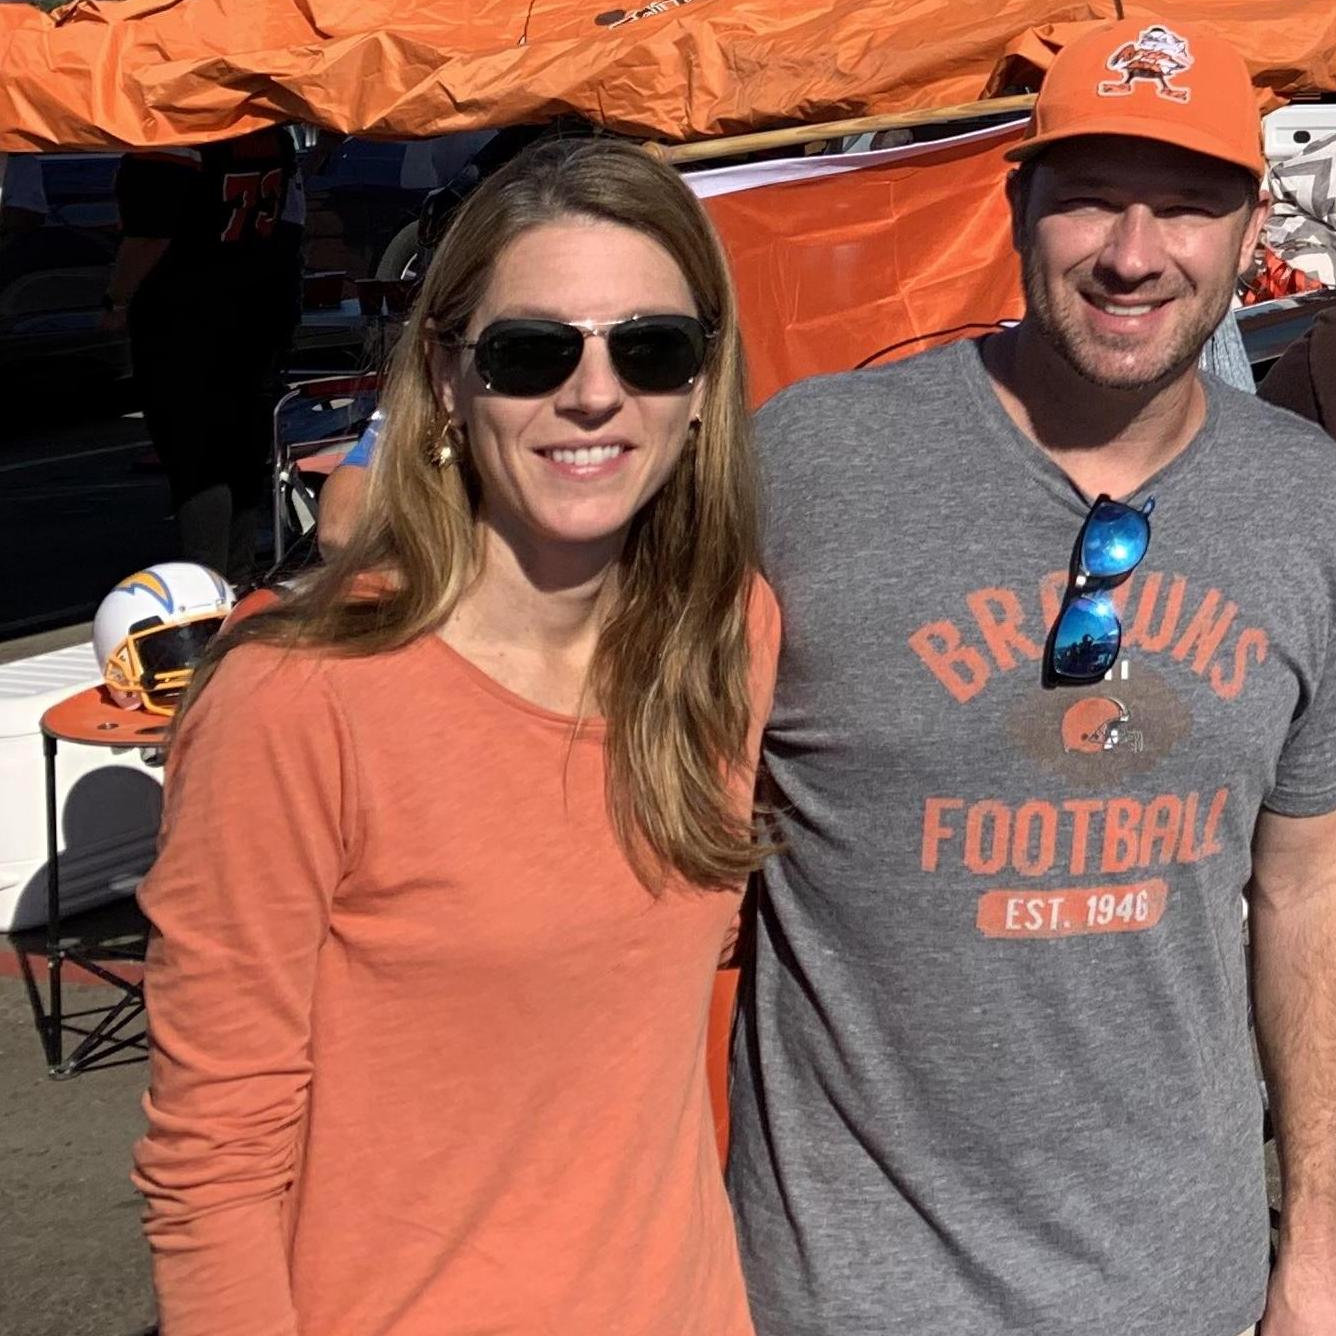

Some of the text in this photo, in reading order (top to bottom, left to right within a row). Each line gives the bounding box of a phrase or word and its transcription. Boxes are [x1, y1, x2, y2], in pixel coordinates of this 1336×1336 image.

[921, 787, 1229, 877] FOOTBALL
[1005, 889, 1150, 931] EST. 1946
